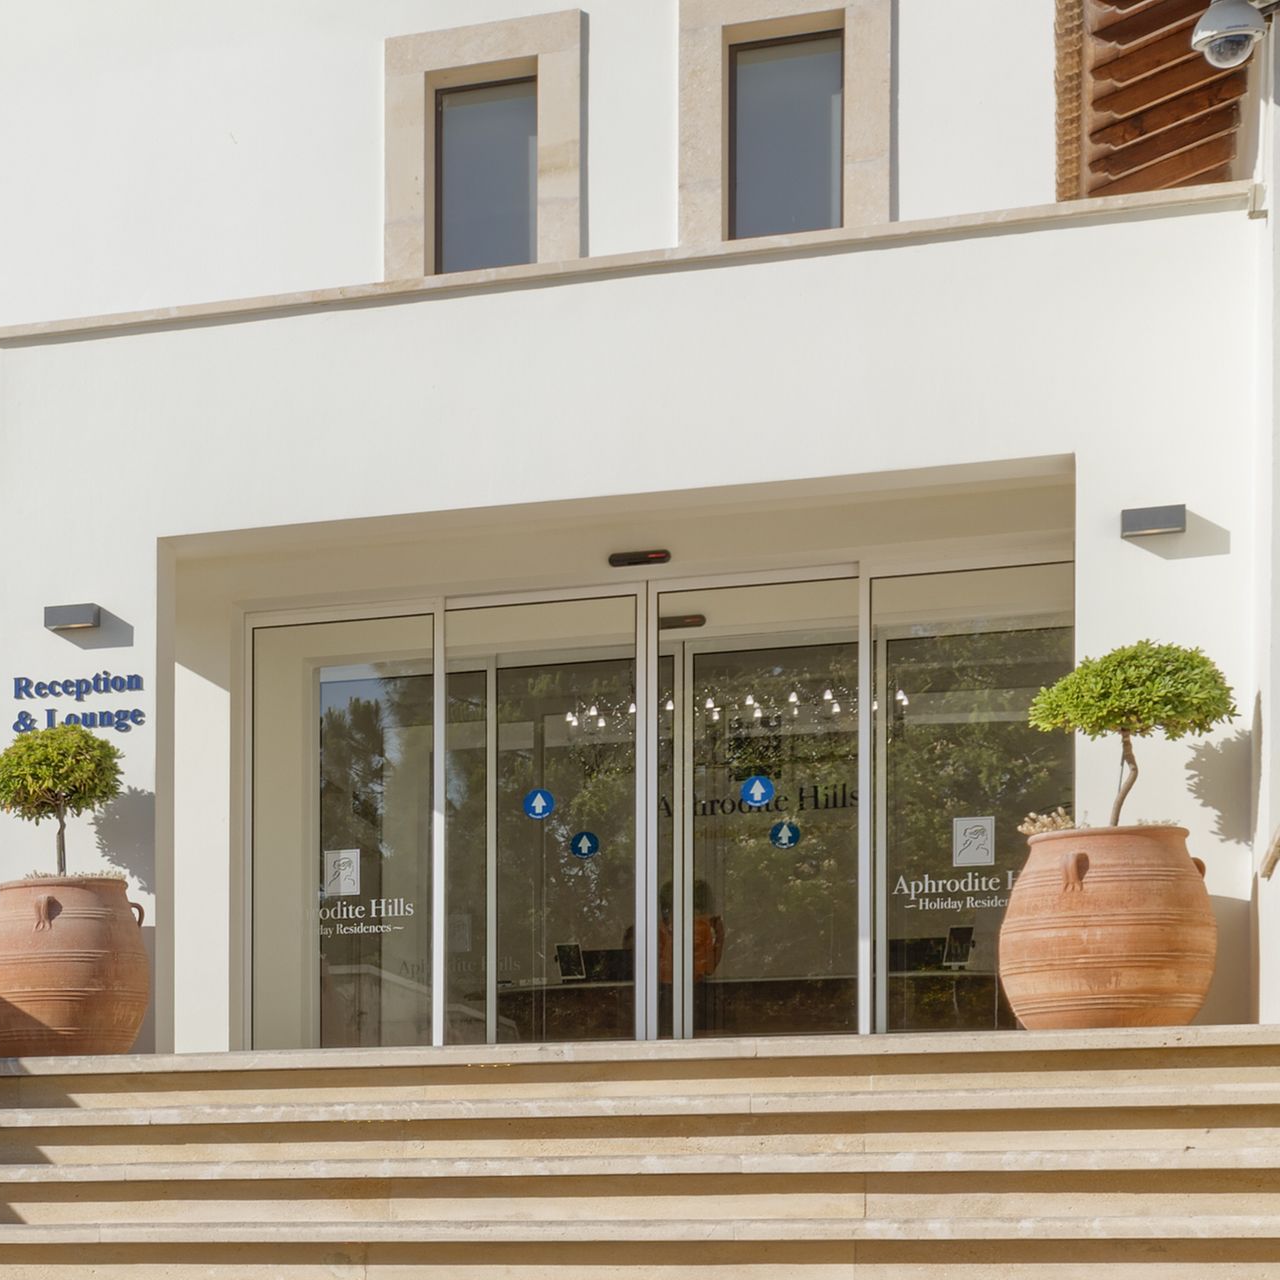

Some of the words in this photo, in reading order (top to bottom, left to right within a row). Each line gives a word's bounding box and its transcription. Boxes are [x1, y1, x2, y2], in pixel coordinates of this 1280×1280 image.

[13, 671, 144, 702] Reception
[13, 711, 37, 733] &
[892, 872, 1001, 900] Aphrodite
[370, 898, 414, 918] Hills
[919, 898, 964, 912] Holiday
[336, 923, 392, 935] Residences
